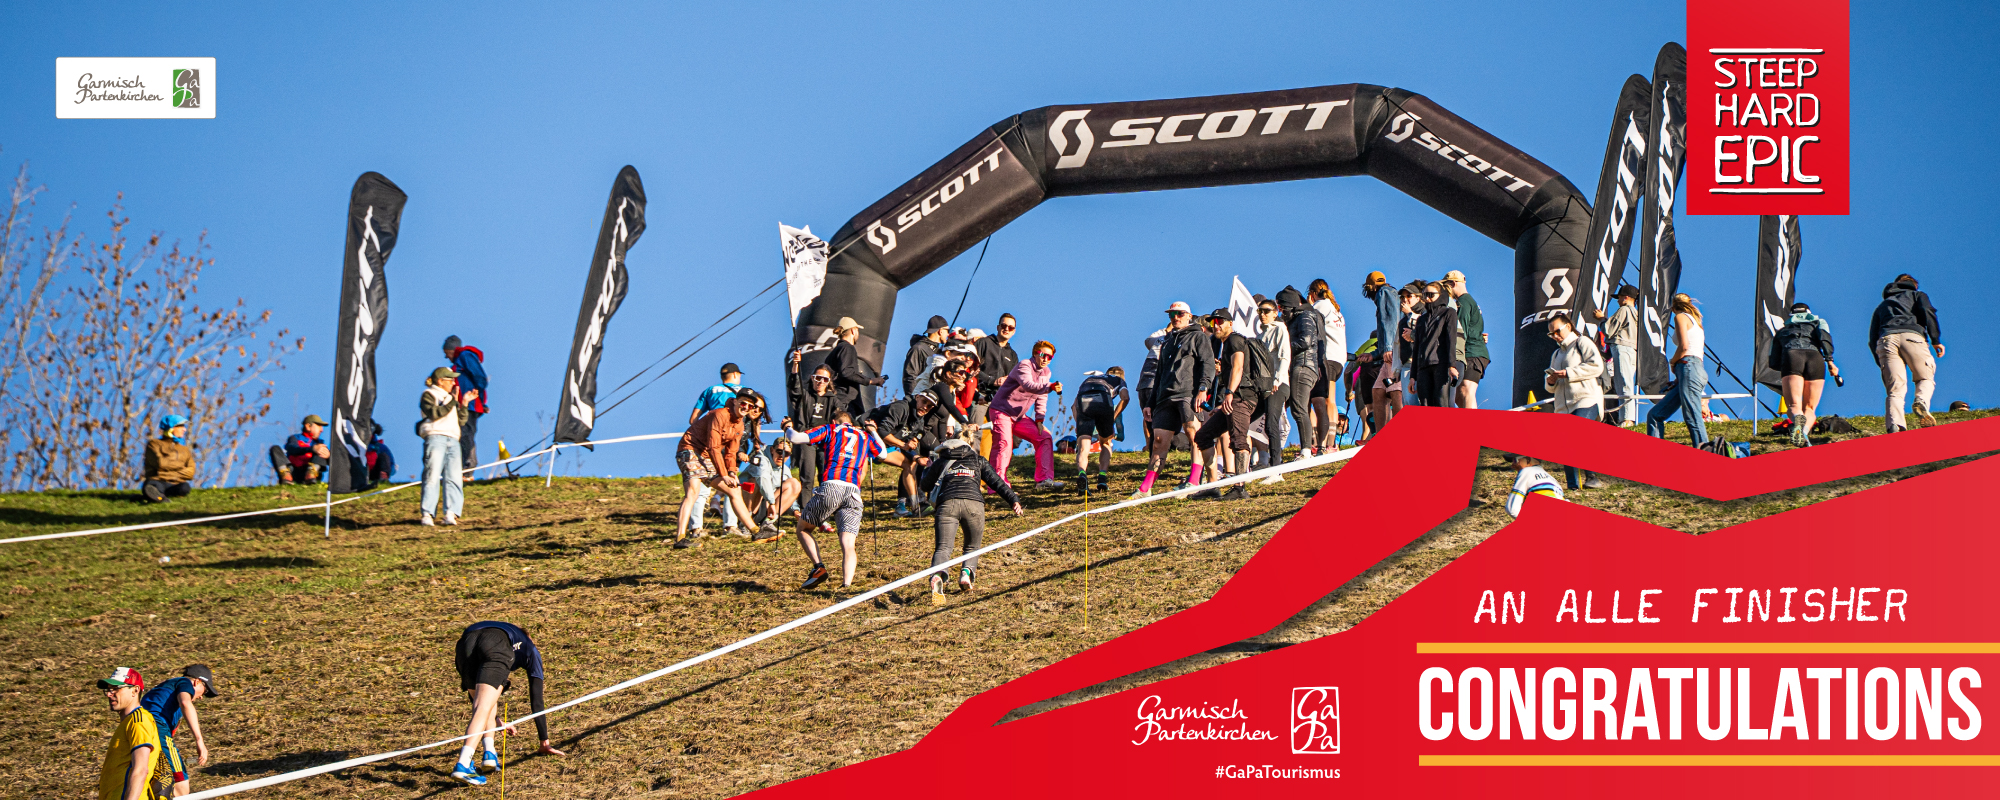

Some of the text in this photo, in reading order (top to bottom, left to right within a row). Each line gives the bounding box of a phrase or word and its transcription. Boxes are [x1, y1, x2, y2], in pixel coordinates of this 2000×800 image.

[1101, 99, 1350, 149] SCOTT
[897, 147, 1003, 234] SCOTT
[1411, 131, 1535, 193] SCOTT
[1592, 110, 1646, 312] SCOTT
[844, 431, 858, 454] 7
